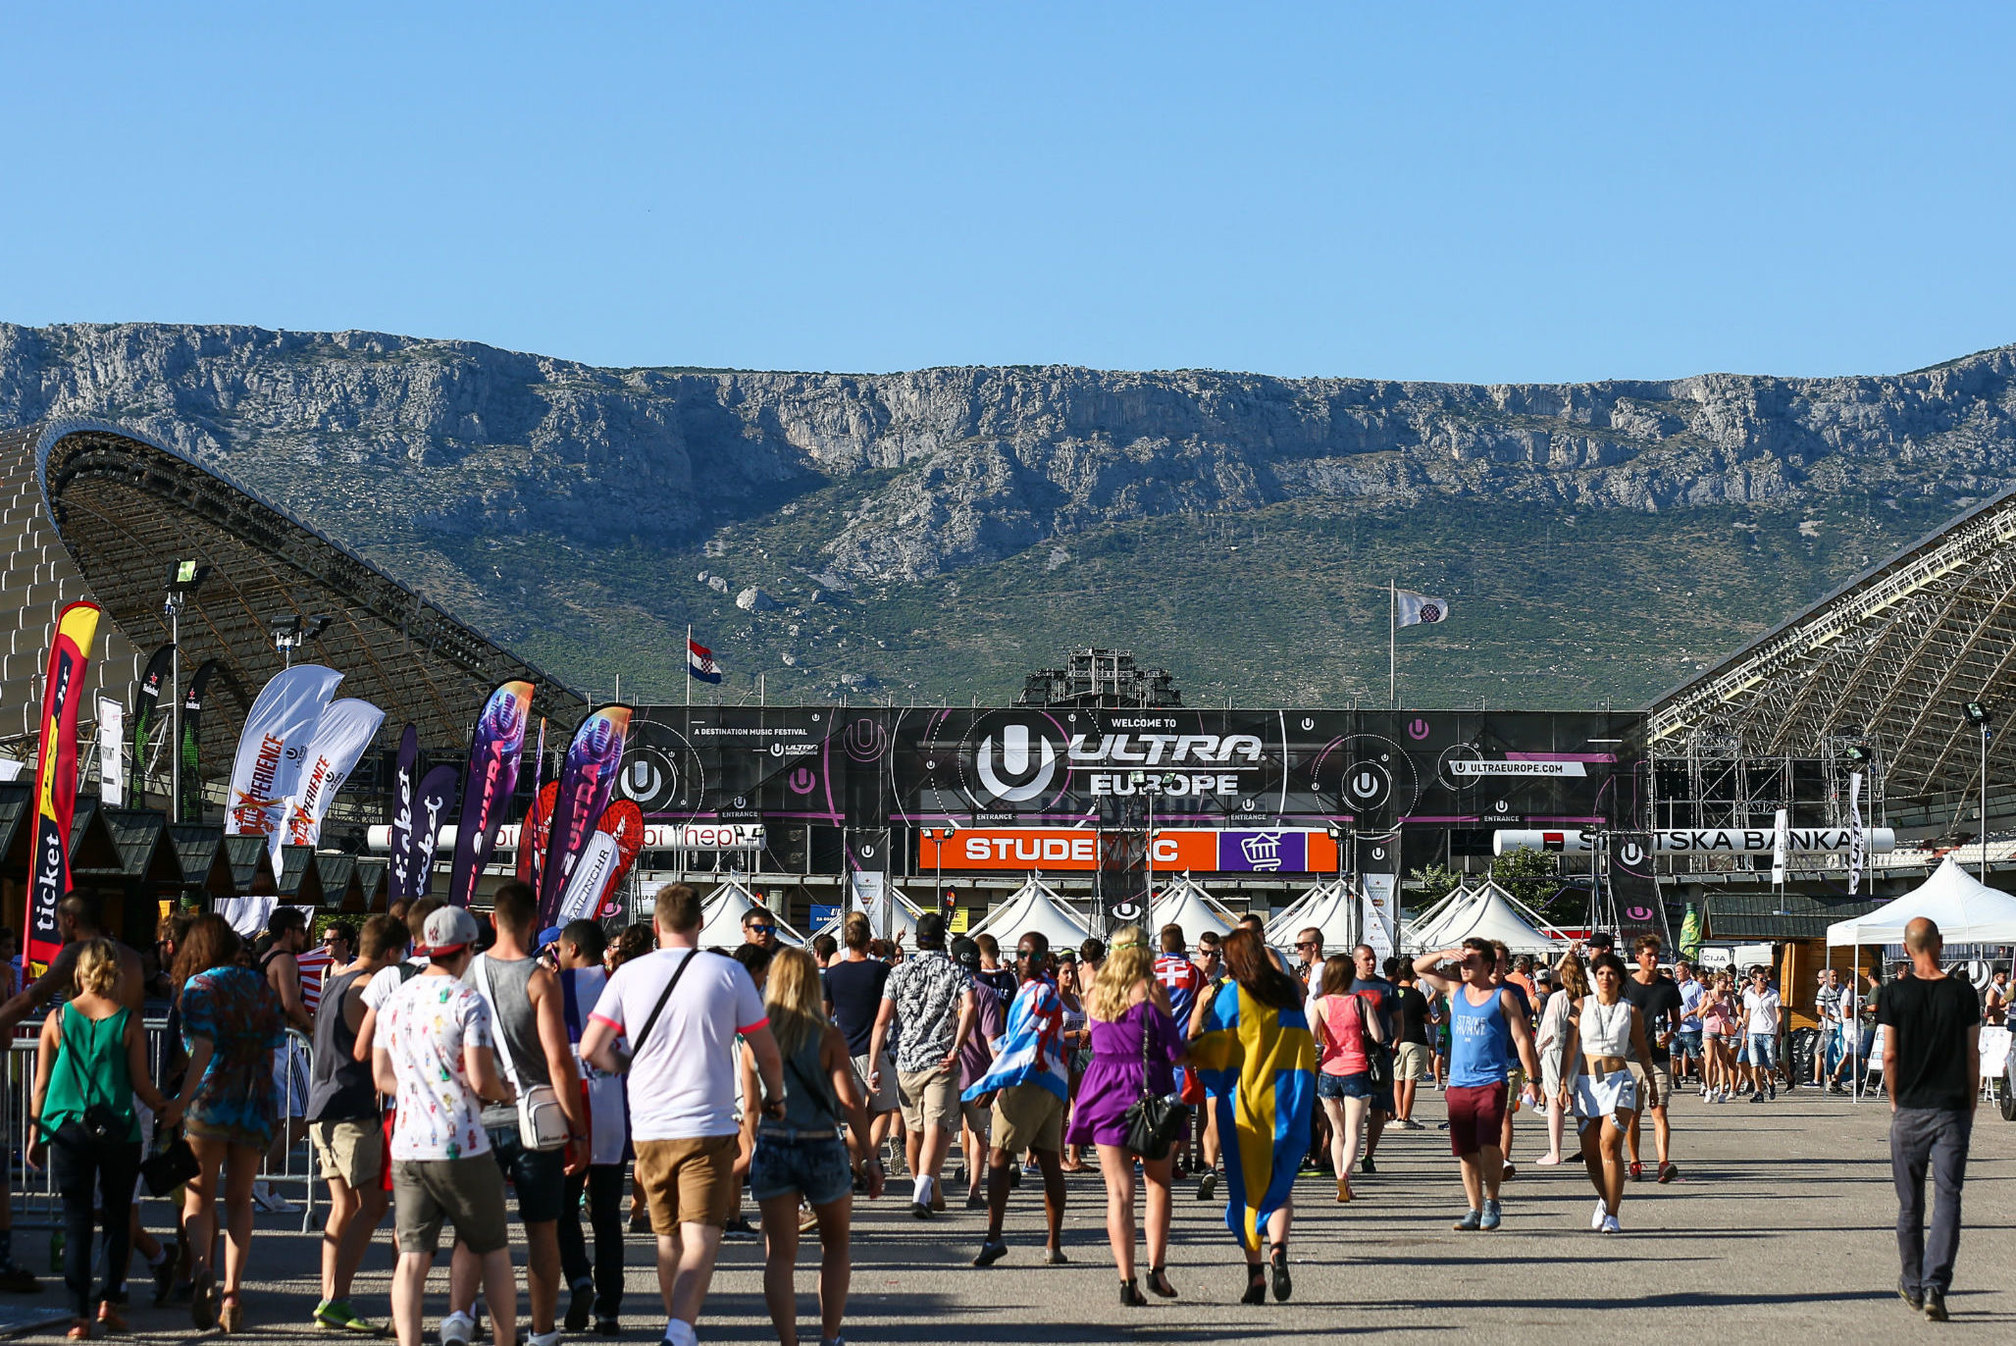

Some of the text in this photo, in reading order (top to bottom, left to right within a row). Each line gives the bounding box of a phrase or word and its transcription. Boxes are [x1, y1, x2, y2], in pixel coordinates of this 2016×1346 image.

[1111, 719, 1177, 728] WELCOME TO
[785, 744, 818, 752] ULTRA
[1067, 734, 1263, 765] ULTRA
[1470, 764, 1563, 773] ULTRAEUROPE.COM
[470, 740, 504, 831] ULTRA
[1090, 774, 1238, 796] EUROPE
[568, 763, 601, 851] ULTRA
[35, 833, 60, 931] ticket
[1703, 954, 1726, 962] CIJA
